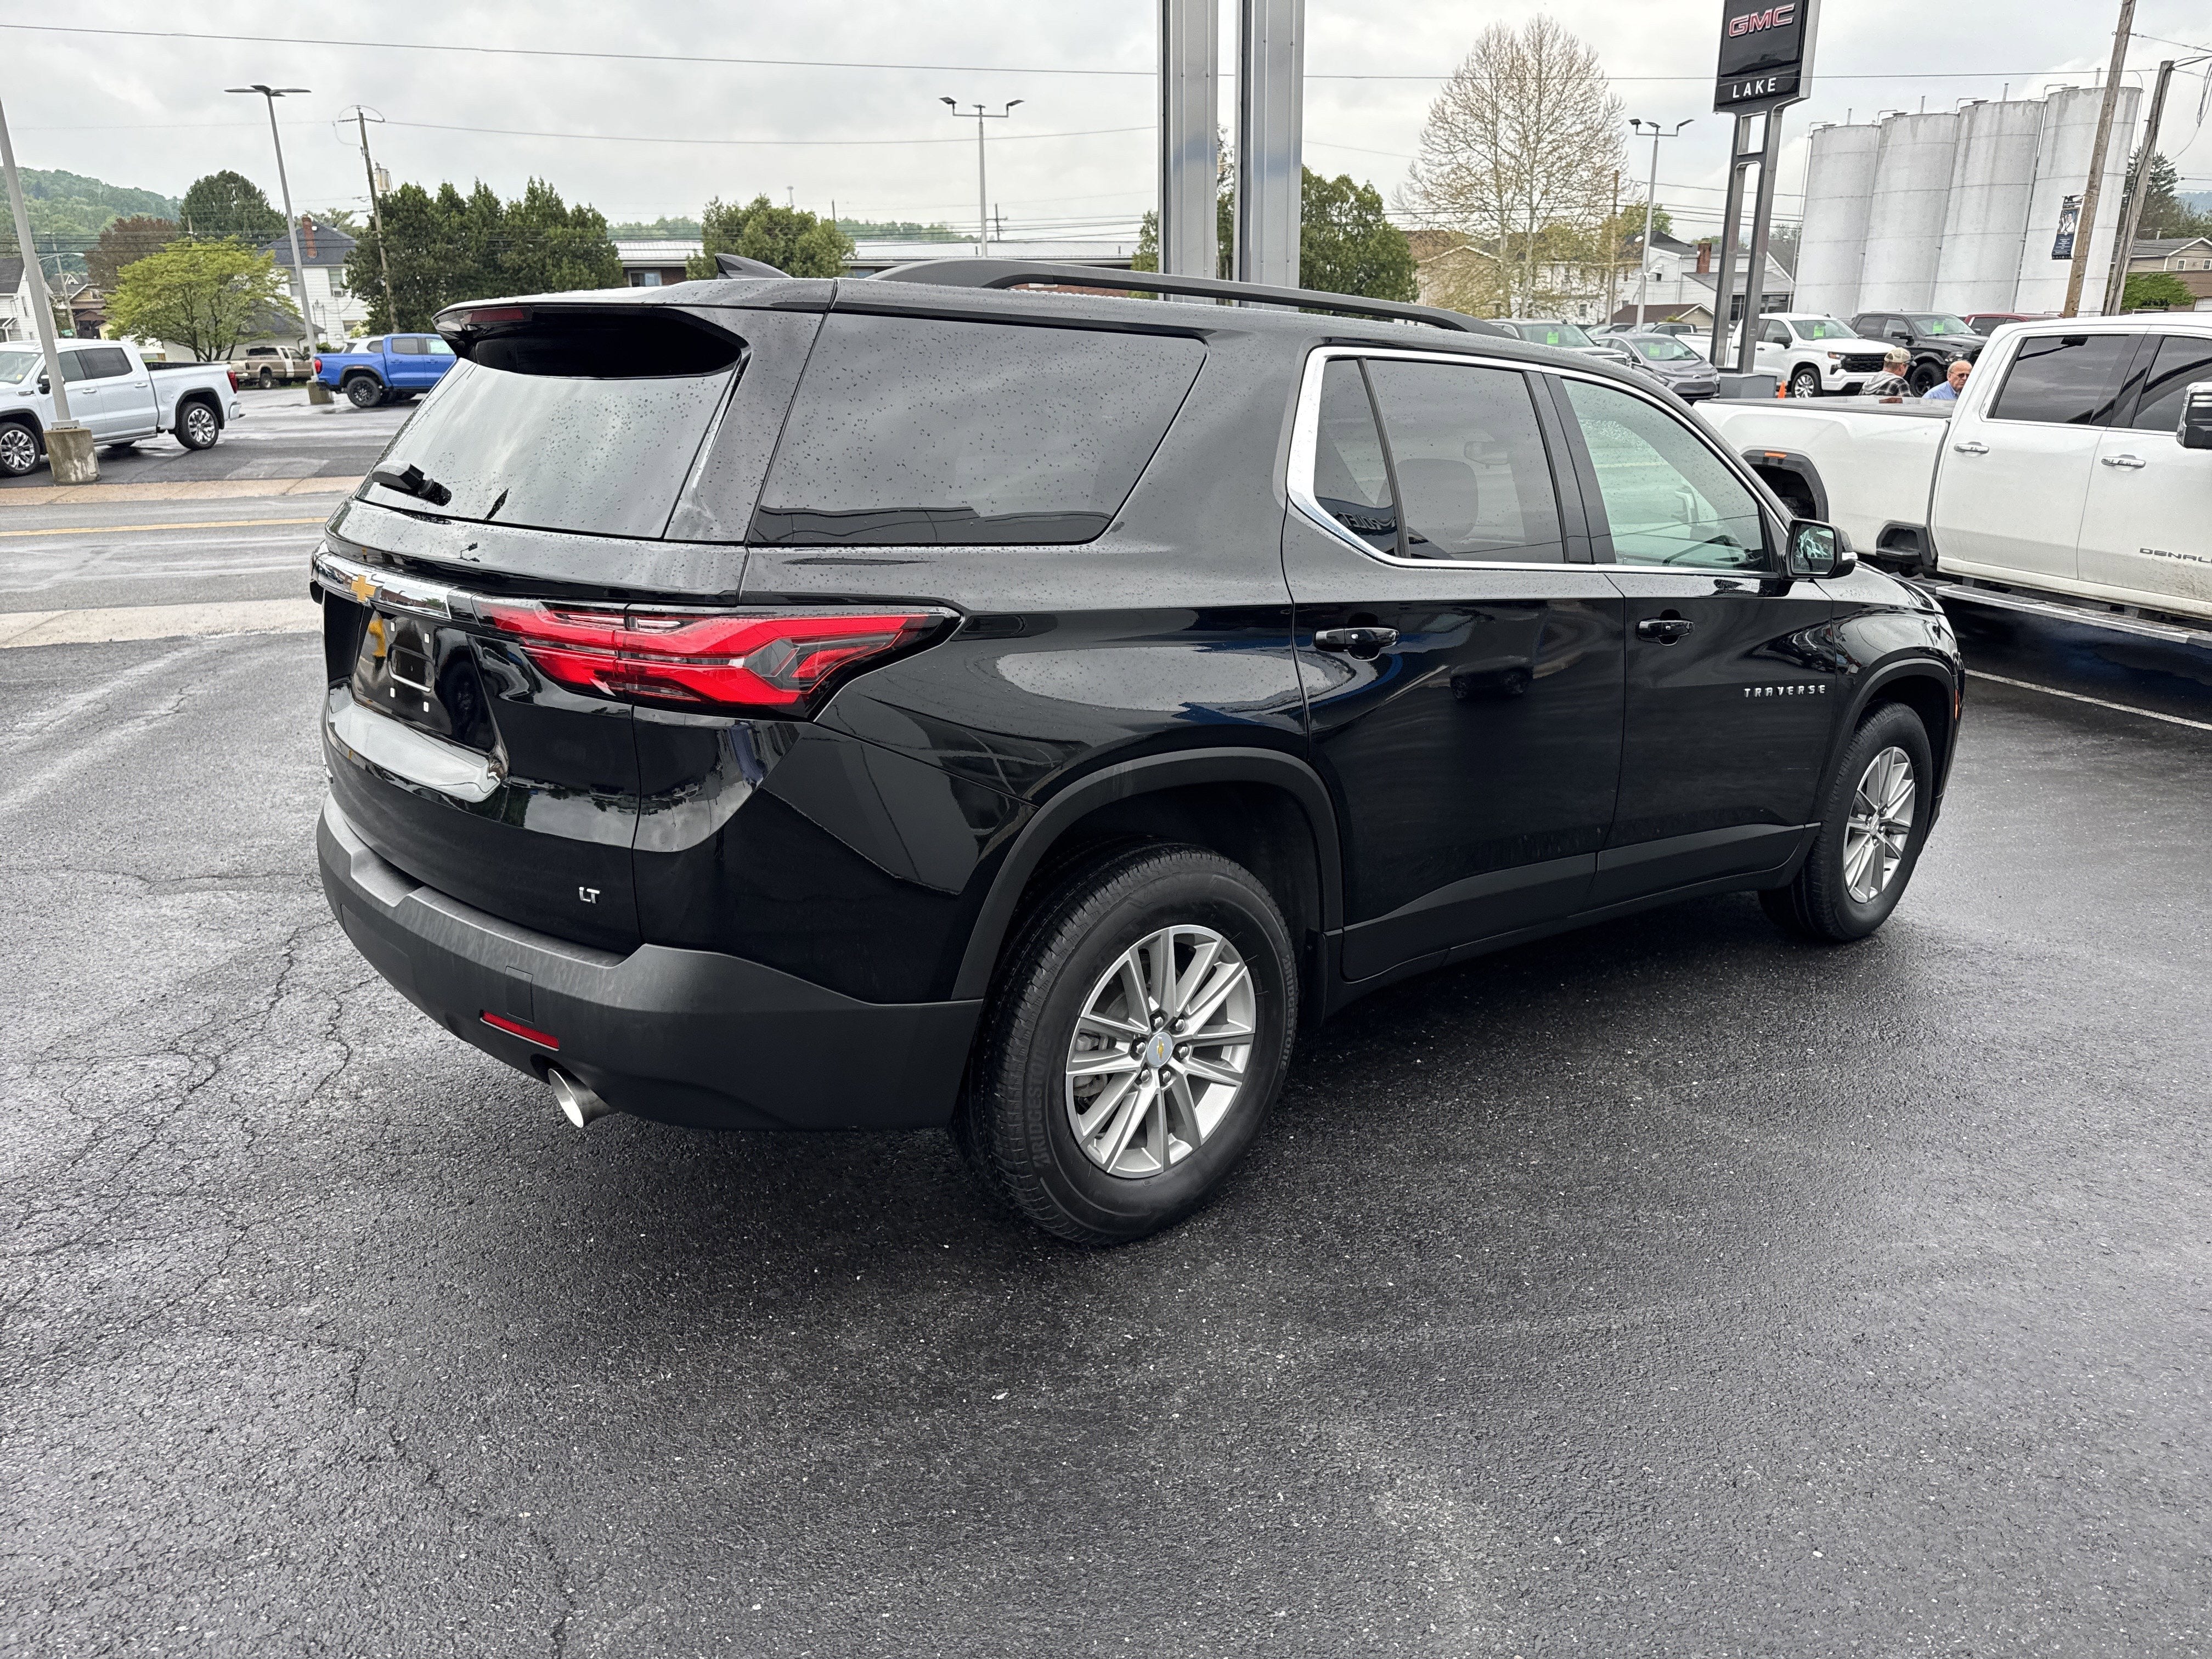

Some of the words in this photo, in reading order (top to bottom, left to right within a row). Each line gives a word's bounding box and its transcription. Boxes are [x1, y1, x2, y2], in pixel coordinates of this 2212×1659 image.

[1729, 3, 1796, 38] GMC
[1732, 77, 1777, 99] LAKE
[1744, 685, 1825, 698] TRAVERSE
[579, 887, 600, 904] LT
